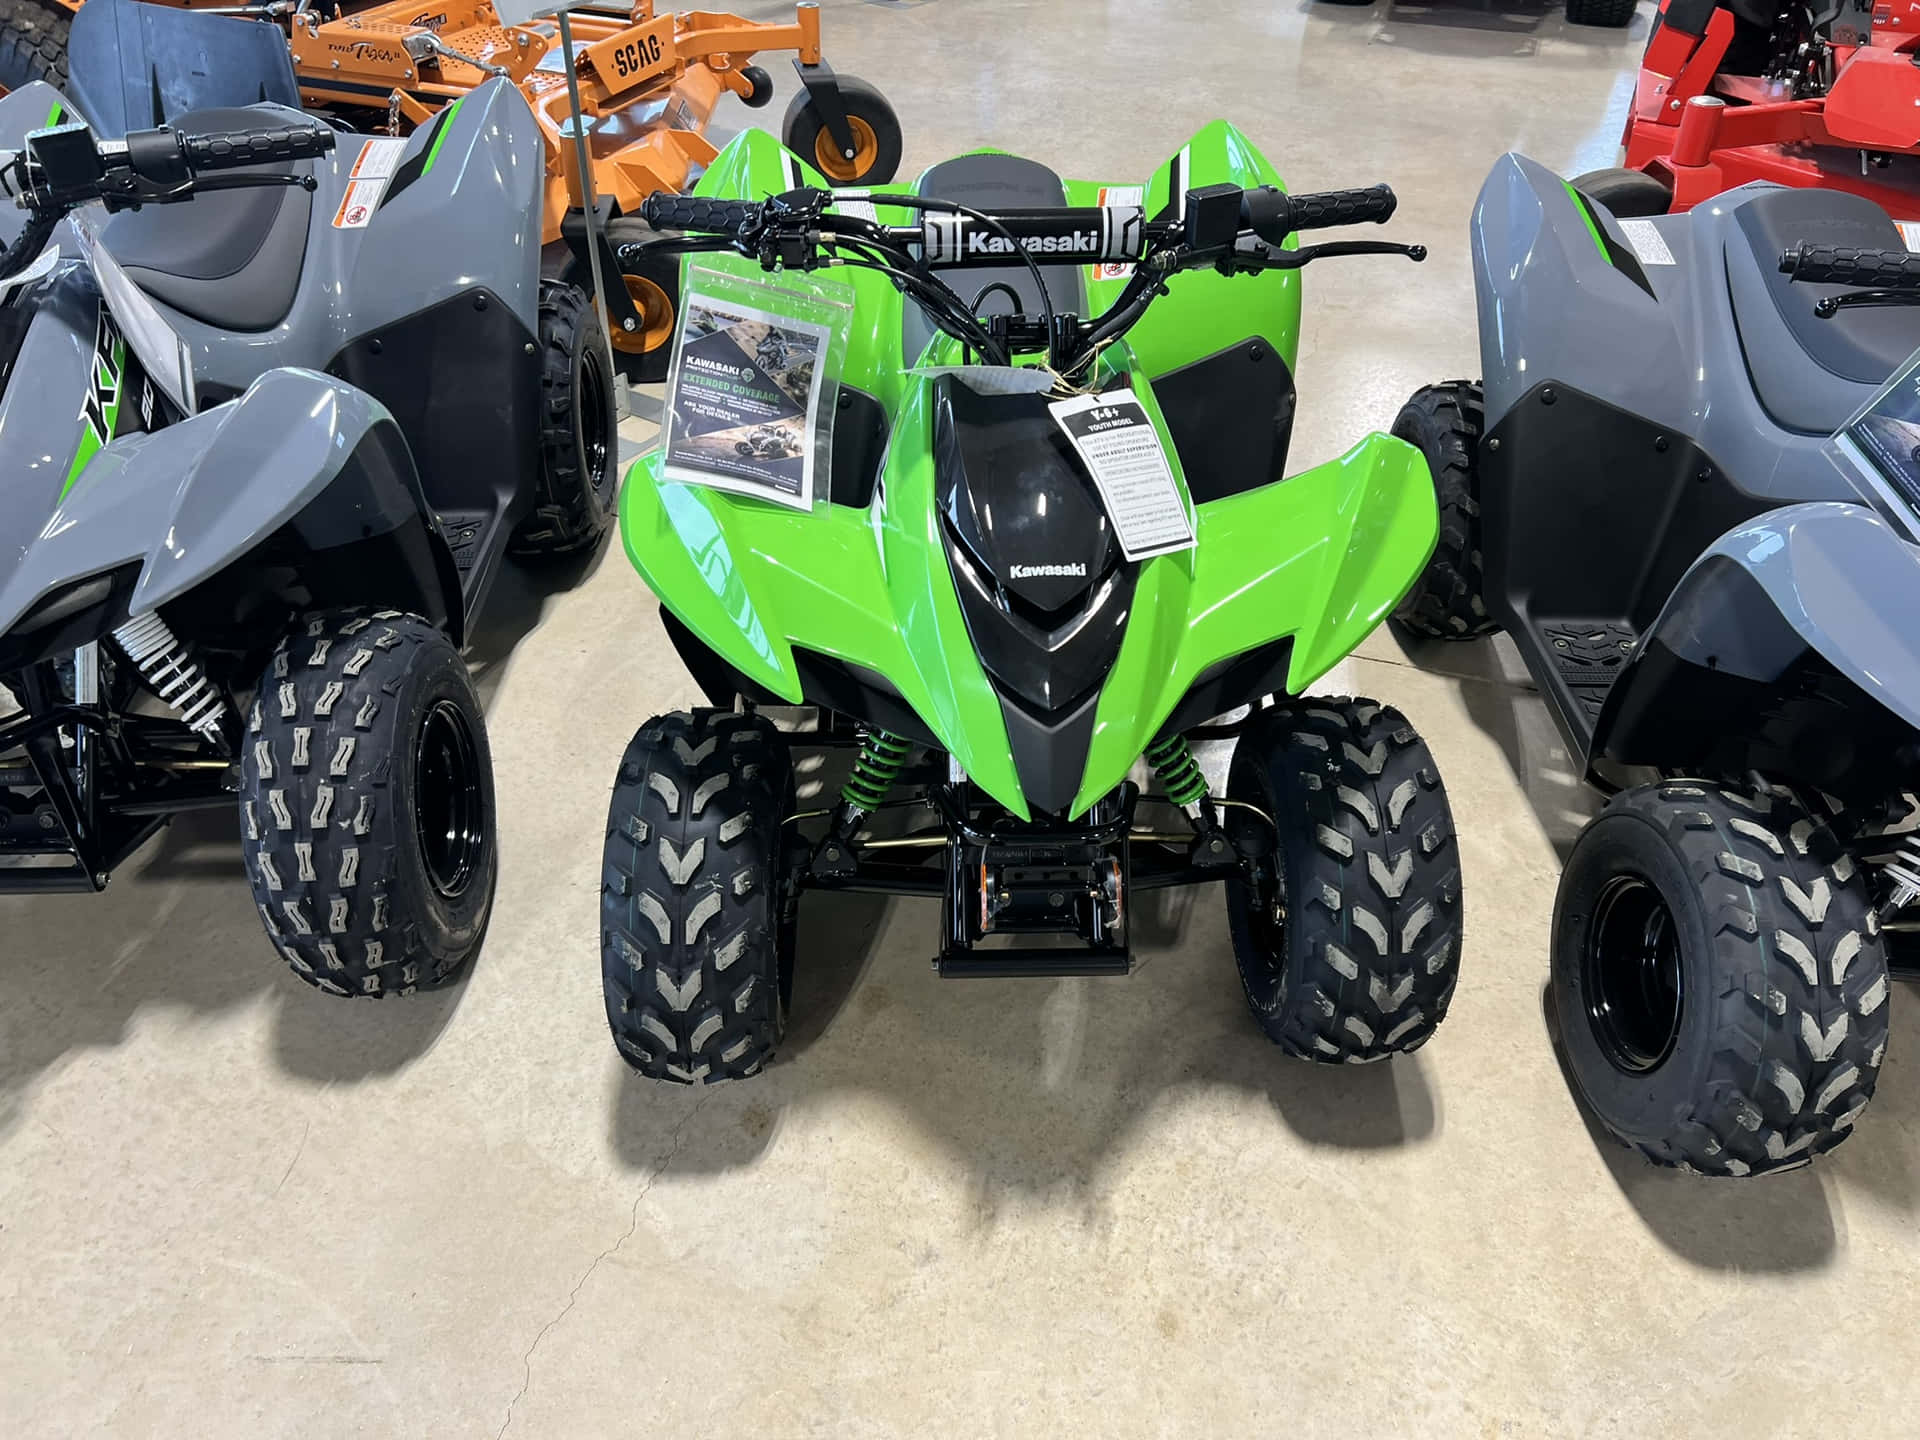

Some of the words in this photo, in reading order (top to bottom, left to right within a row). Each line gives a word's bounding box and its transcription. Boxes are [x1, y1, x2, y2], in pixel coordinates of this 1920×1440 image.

[614, 34, 661, 77] SCAG
[968, 230, 1098, 253] Kawasaki
[686, 354, 740, 376] KAWASAKI
[683, 372, 730, 391] EXTENDED
[732, 384, 781, 403] COVERAGE
[1088, 421, 1112, 431] YOUTH
[1111, 417, 1134, 427] MODEL
[1009, 562, 1087, 579] Kawasaki
